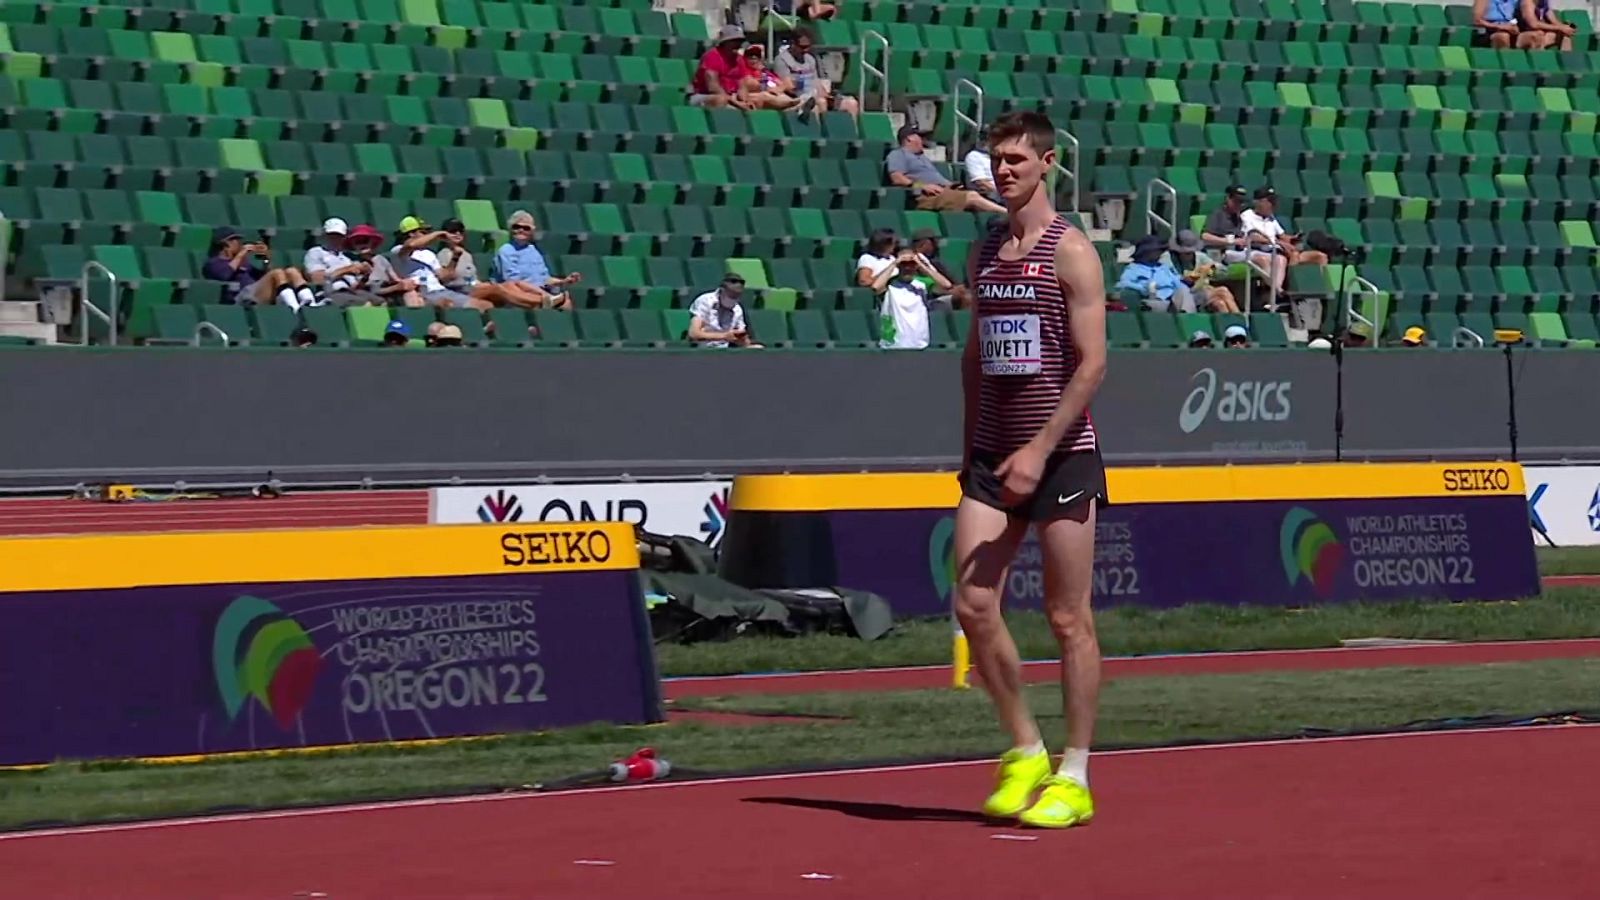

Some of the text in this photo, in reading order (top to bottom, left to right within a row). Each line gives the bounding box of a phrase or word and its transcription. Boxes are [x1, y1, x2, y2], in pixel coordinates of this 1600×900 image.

[978, 284, 1036, 299] CANADA
[990, 319, 1028, 334] TDK
[981, 339, 1033, 358] LOVETT
[1443, 468, 1510, 491] SEIKO
[1346, 513, 1467, 533] WORLD ATHLETICS
[501, 530, 611, 566] SEIKO
[1350, 535, 1470, 555] CHAMPIONSHIPS
[333, 599, 536, 633] WORLD ATHLETICS
[337, 630, 541, 666] CHAMPIONSHIPS
